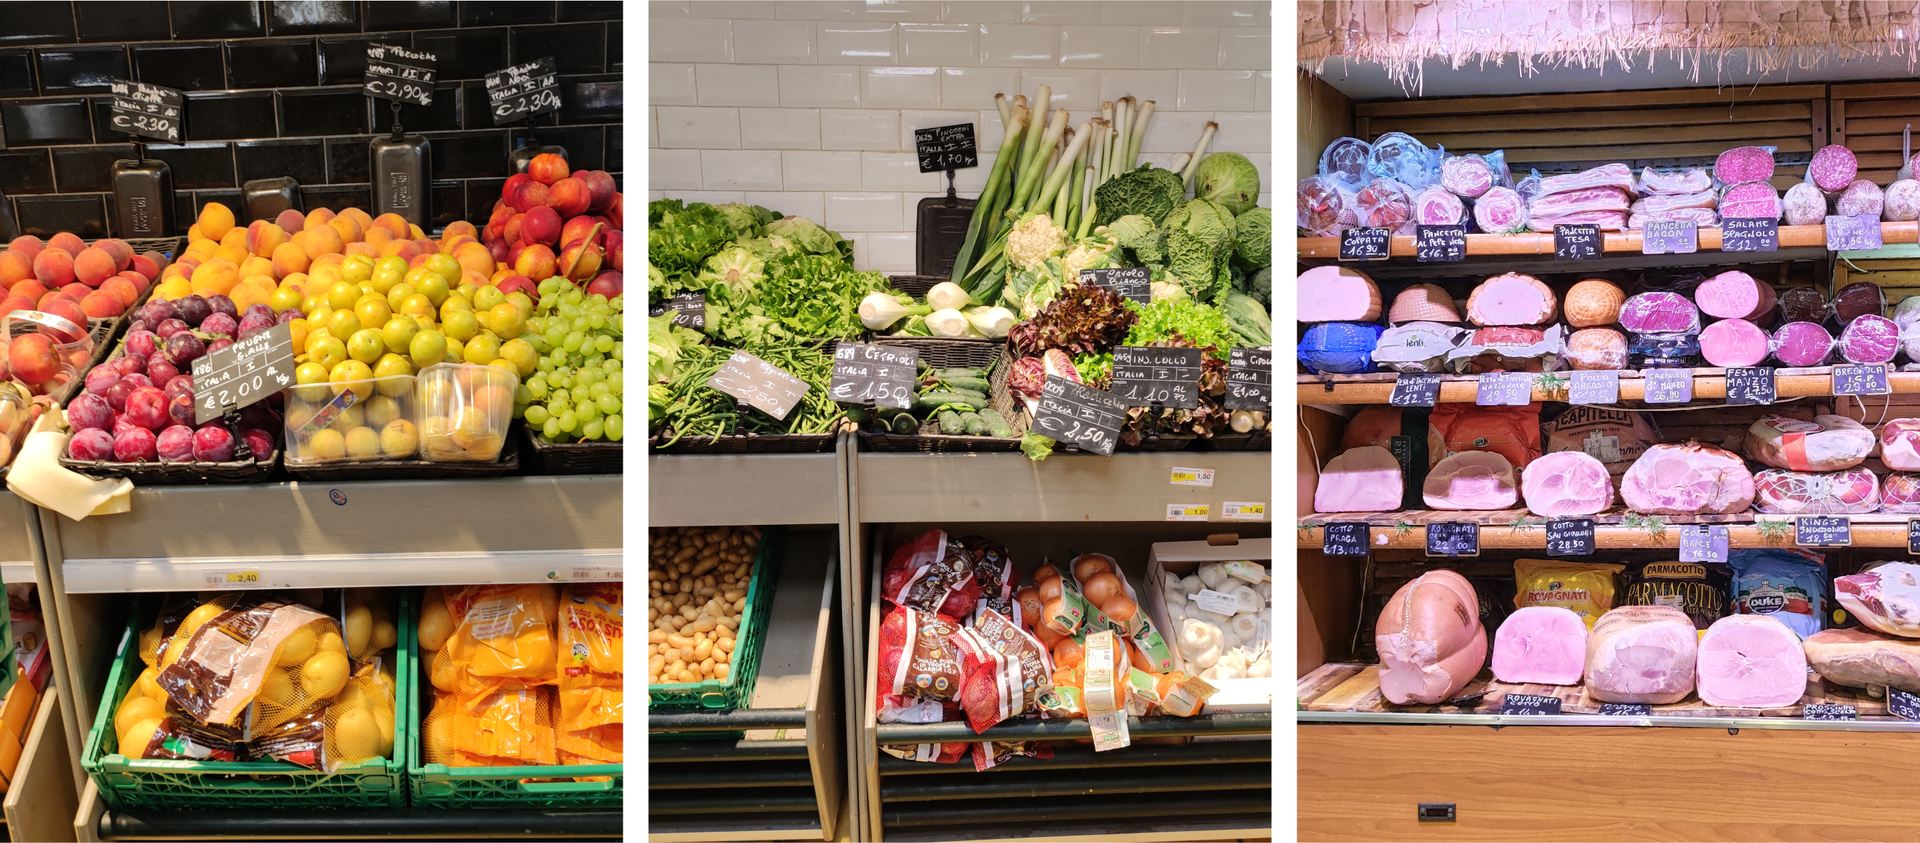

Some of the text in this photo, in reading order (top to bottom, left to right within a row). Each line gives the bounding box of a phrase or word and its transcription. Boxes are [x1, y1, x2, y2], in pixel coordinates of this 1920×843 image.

[366, 81, 384, 93] €
[523, 81, 536, 91] I
[496, 104, 514, 116] €
[113, 115, 131, 127] €
[919, 146, 943, 154] ITALIA
[921, 157, 933, 169] €
[1648, 221, 1693, 231] PANCETTA
[1728, 220, 1768, 229] SALAME
[1423, 229, 1463, 238] PANCETTA
[1647, 230, 1684, 239] BACON
[1722, 230, 1775, 239] SPAGNOLO
[232, 330, 272, 353] PRUGNE
[1406, 338, 1423, 347] lenti
[837, 347, 915, 366] 689 CETRIOLI
[246, 361, 256, 371] I
[838, 366, 889, 377] ITALIA I
[1158, 370, 1169, 379] I
[714, 377, 735, 390] €
[763, 380, 775, 389] I
[203, 396, 216, 409] €
[218, 375, 263, 405] 2,00
[833, 382, 858, 398] €
[1173, 385, 1186, 393] AL
[1728, 388, 1737, 399] €
[1081, 409, 1094, 419] I
[1037, 417, 1105, 442] € 2,50
[1330, 525, 1353, 533] COTTO
[1553, 522, 1574, 530] COTTO
[1547, 542, 1554, 550] €
[1647, 565, 1704, 575] PARMACOTTO
[238, 575, 257, 583] 2,40
[1528, 591, 1587, 602] ROVAGNATI
[1751, 597, 1782, 606] DUKE
